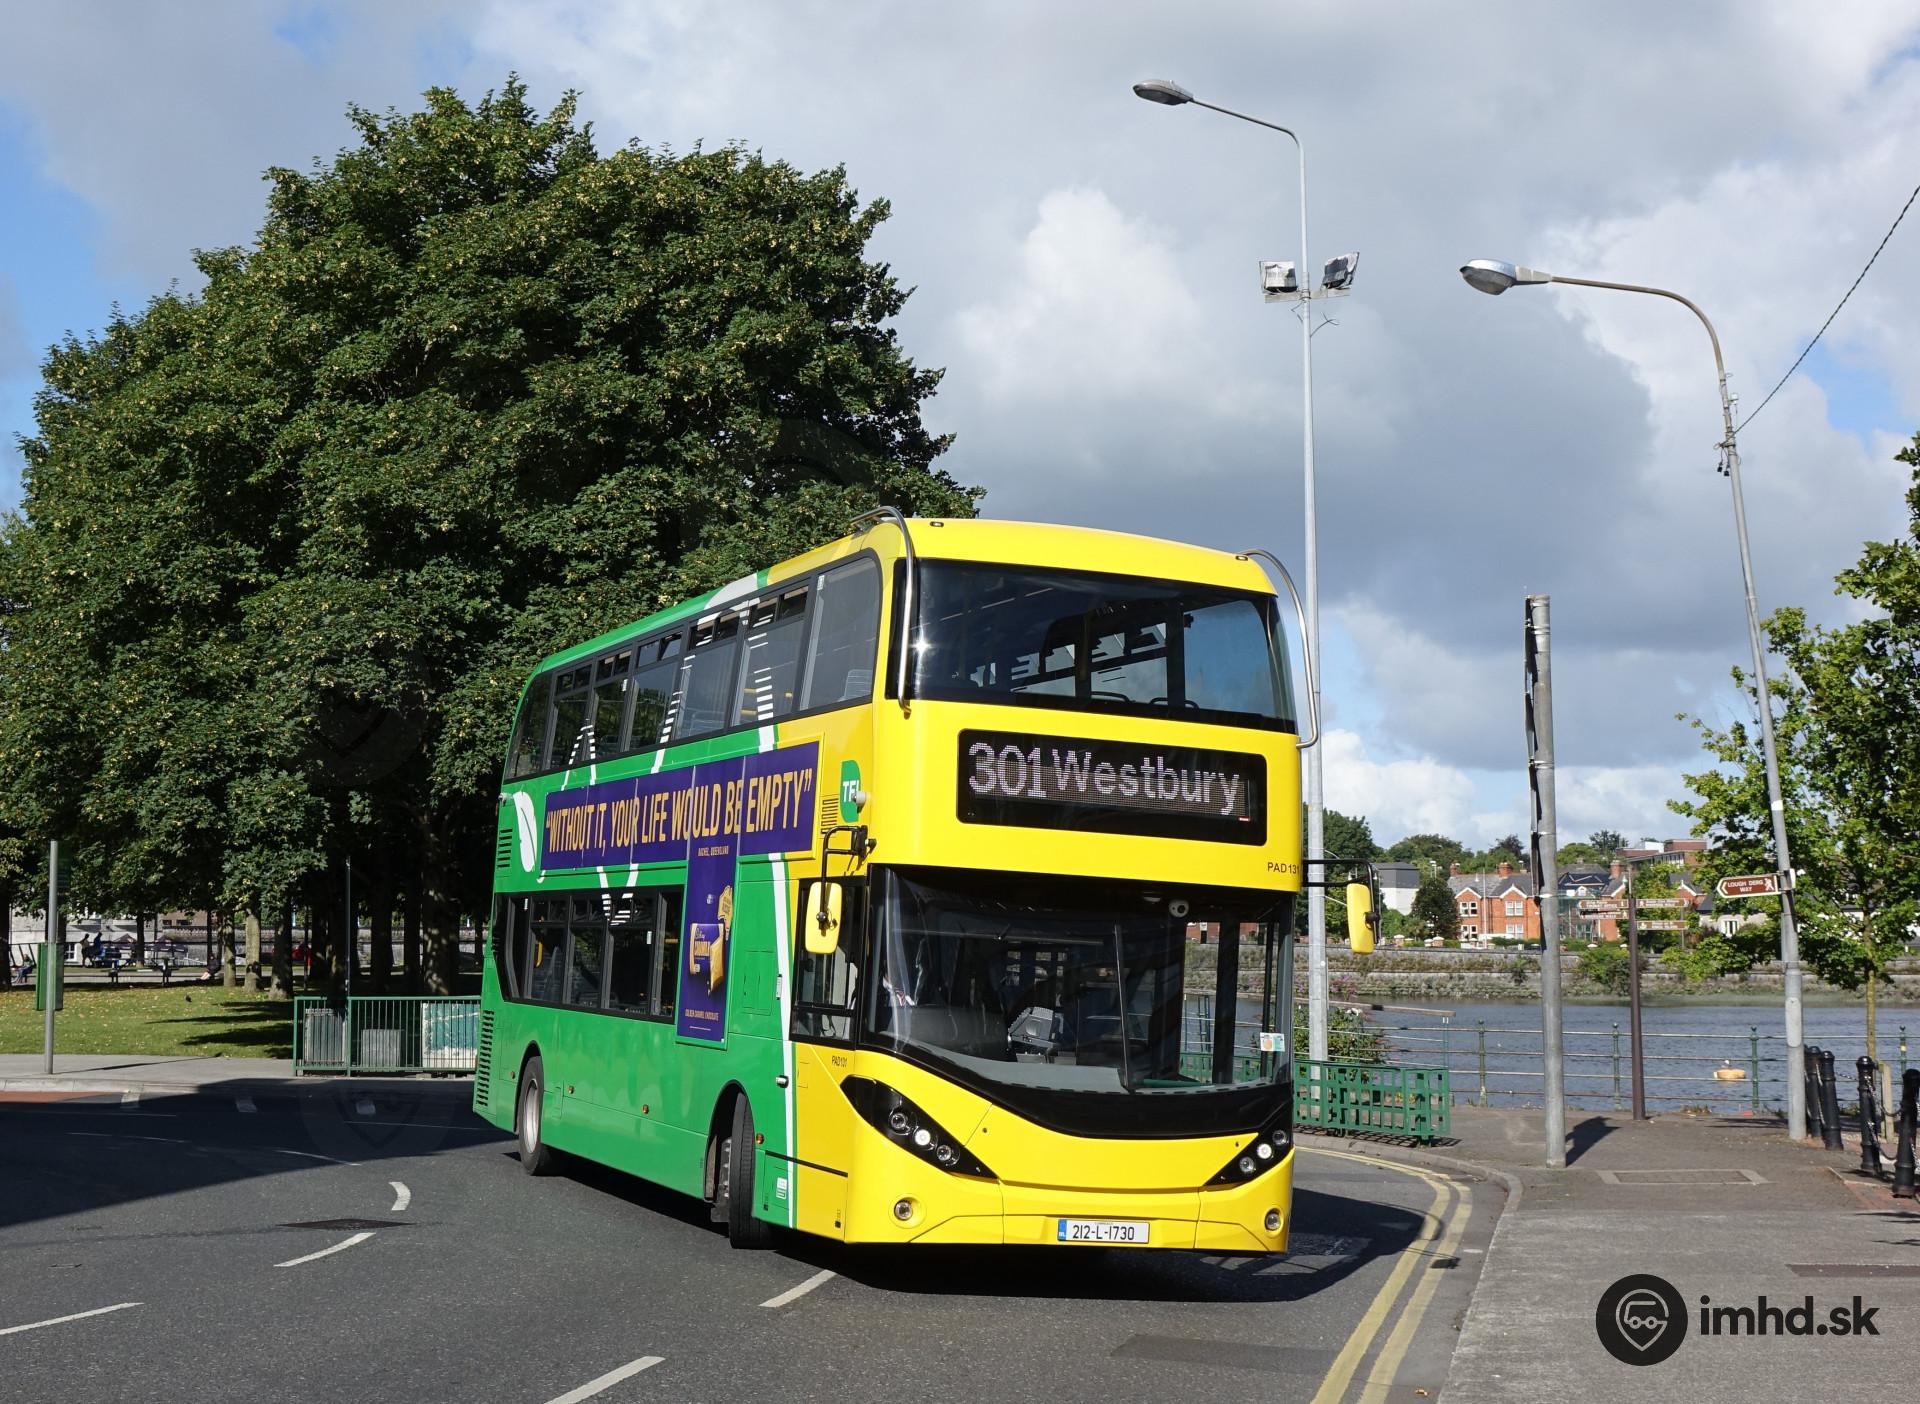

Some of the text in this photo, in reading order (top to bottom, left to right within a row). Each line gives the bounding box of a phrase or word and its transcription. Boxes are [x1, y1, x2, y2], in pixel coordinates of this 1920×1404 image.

[546, 768, 812, 857] “WITHOUT IT, YOUR LIFE WOULD BE EMPTY”
[968, 742, 1240, 816] 301 Westbury
[1072, 1224, 1134, 1241] 212-L-1730
